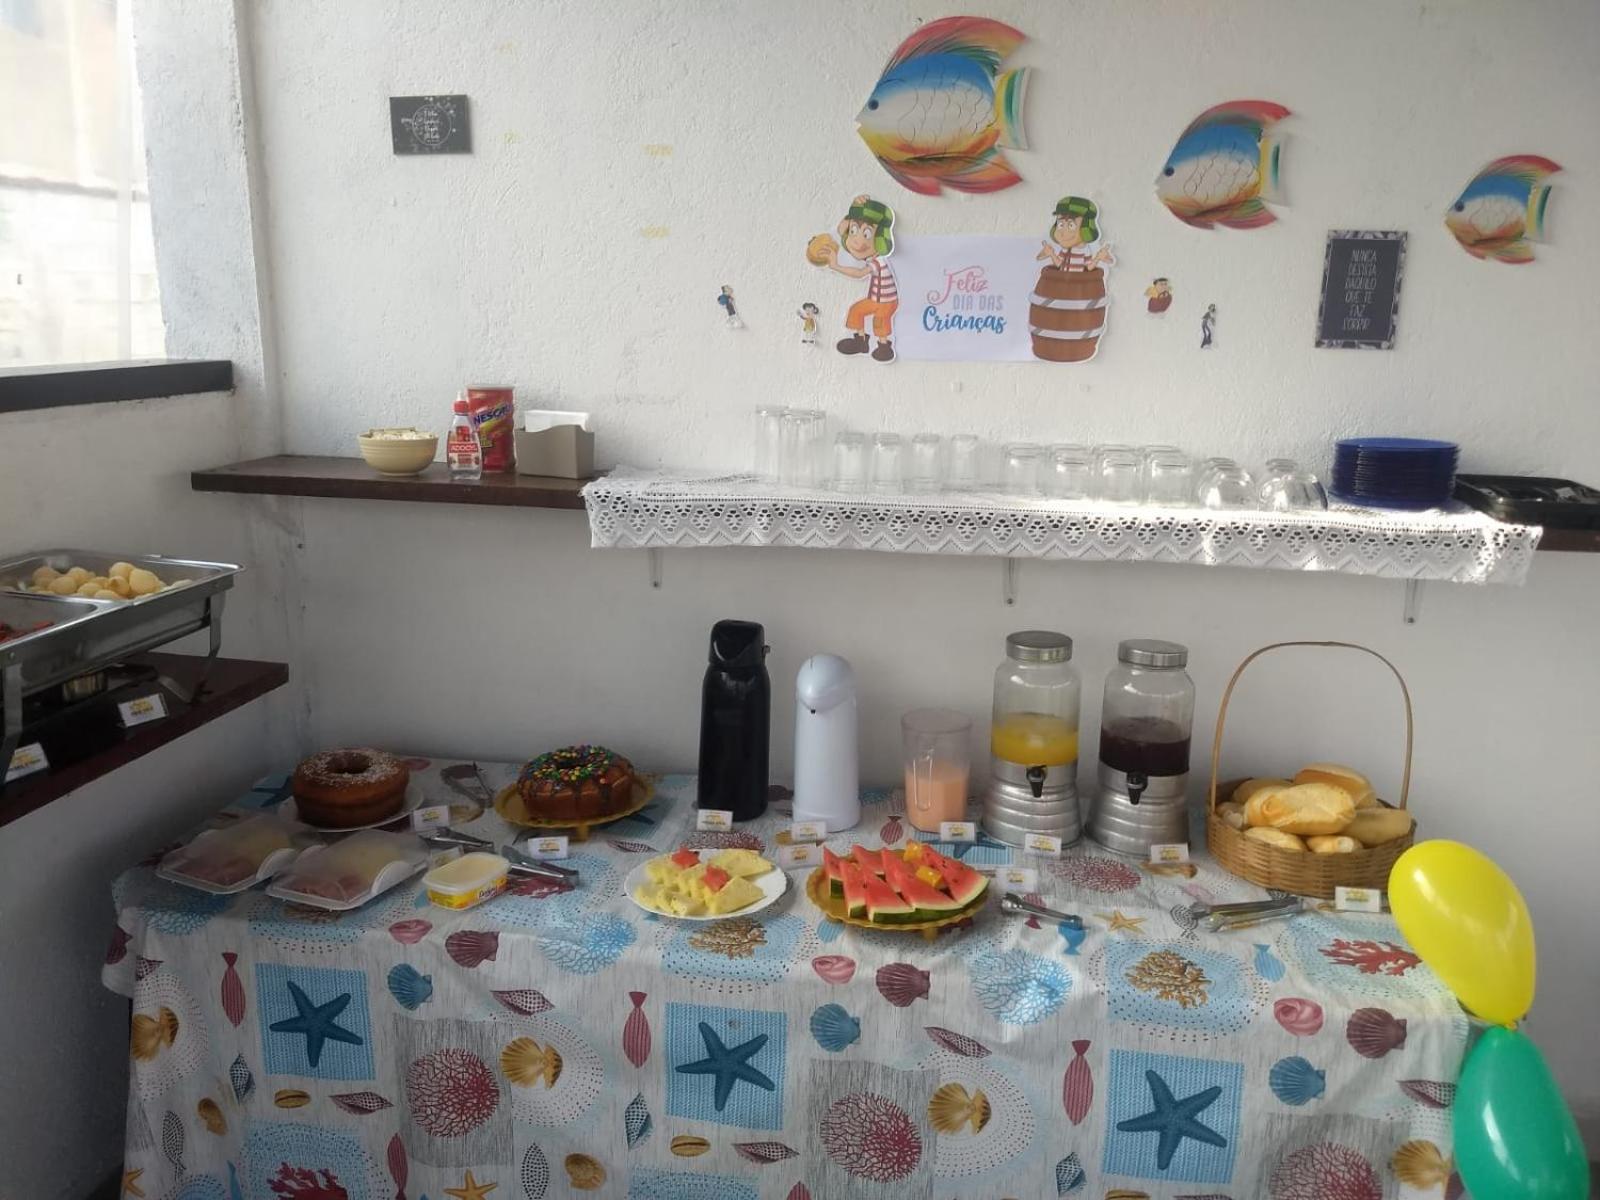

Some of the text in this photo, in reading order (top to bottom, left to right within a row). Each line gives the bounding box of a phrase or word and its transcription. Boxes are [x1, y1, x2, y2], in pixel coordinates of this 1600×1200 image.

[1352, 249, 1377, 261] NUNCA
[927, 265, 988, 305] Feliz
[953, 294, 1004, 311] DIA DAS
[923, 305, 1007, 334] Crianças
